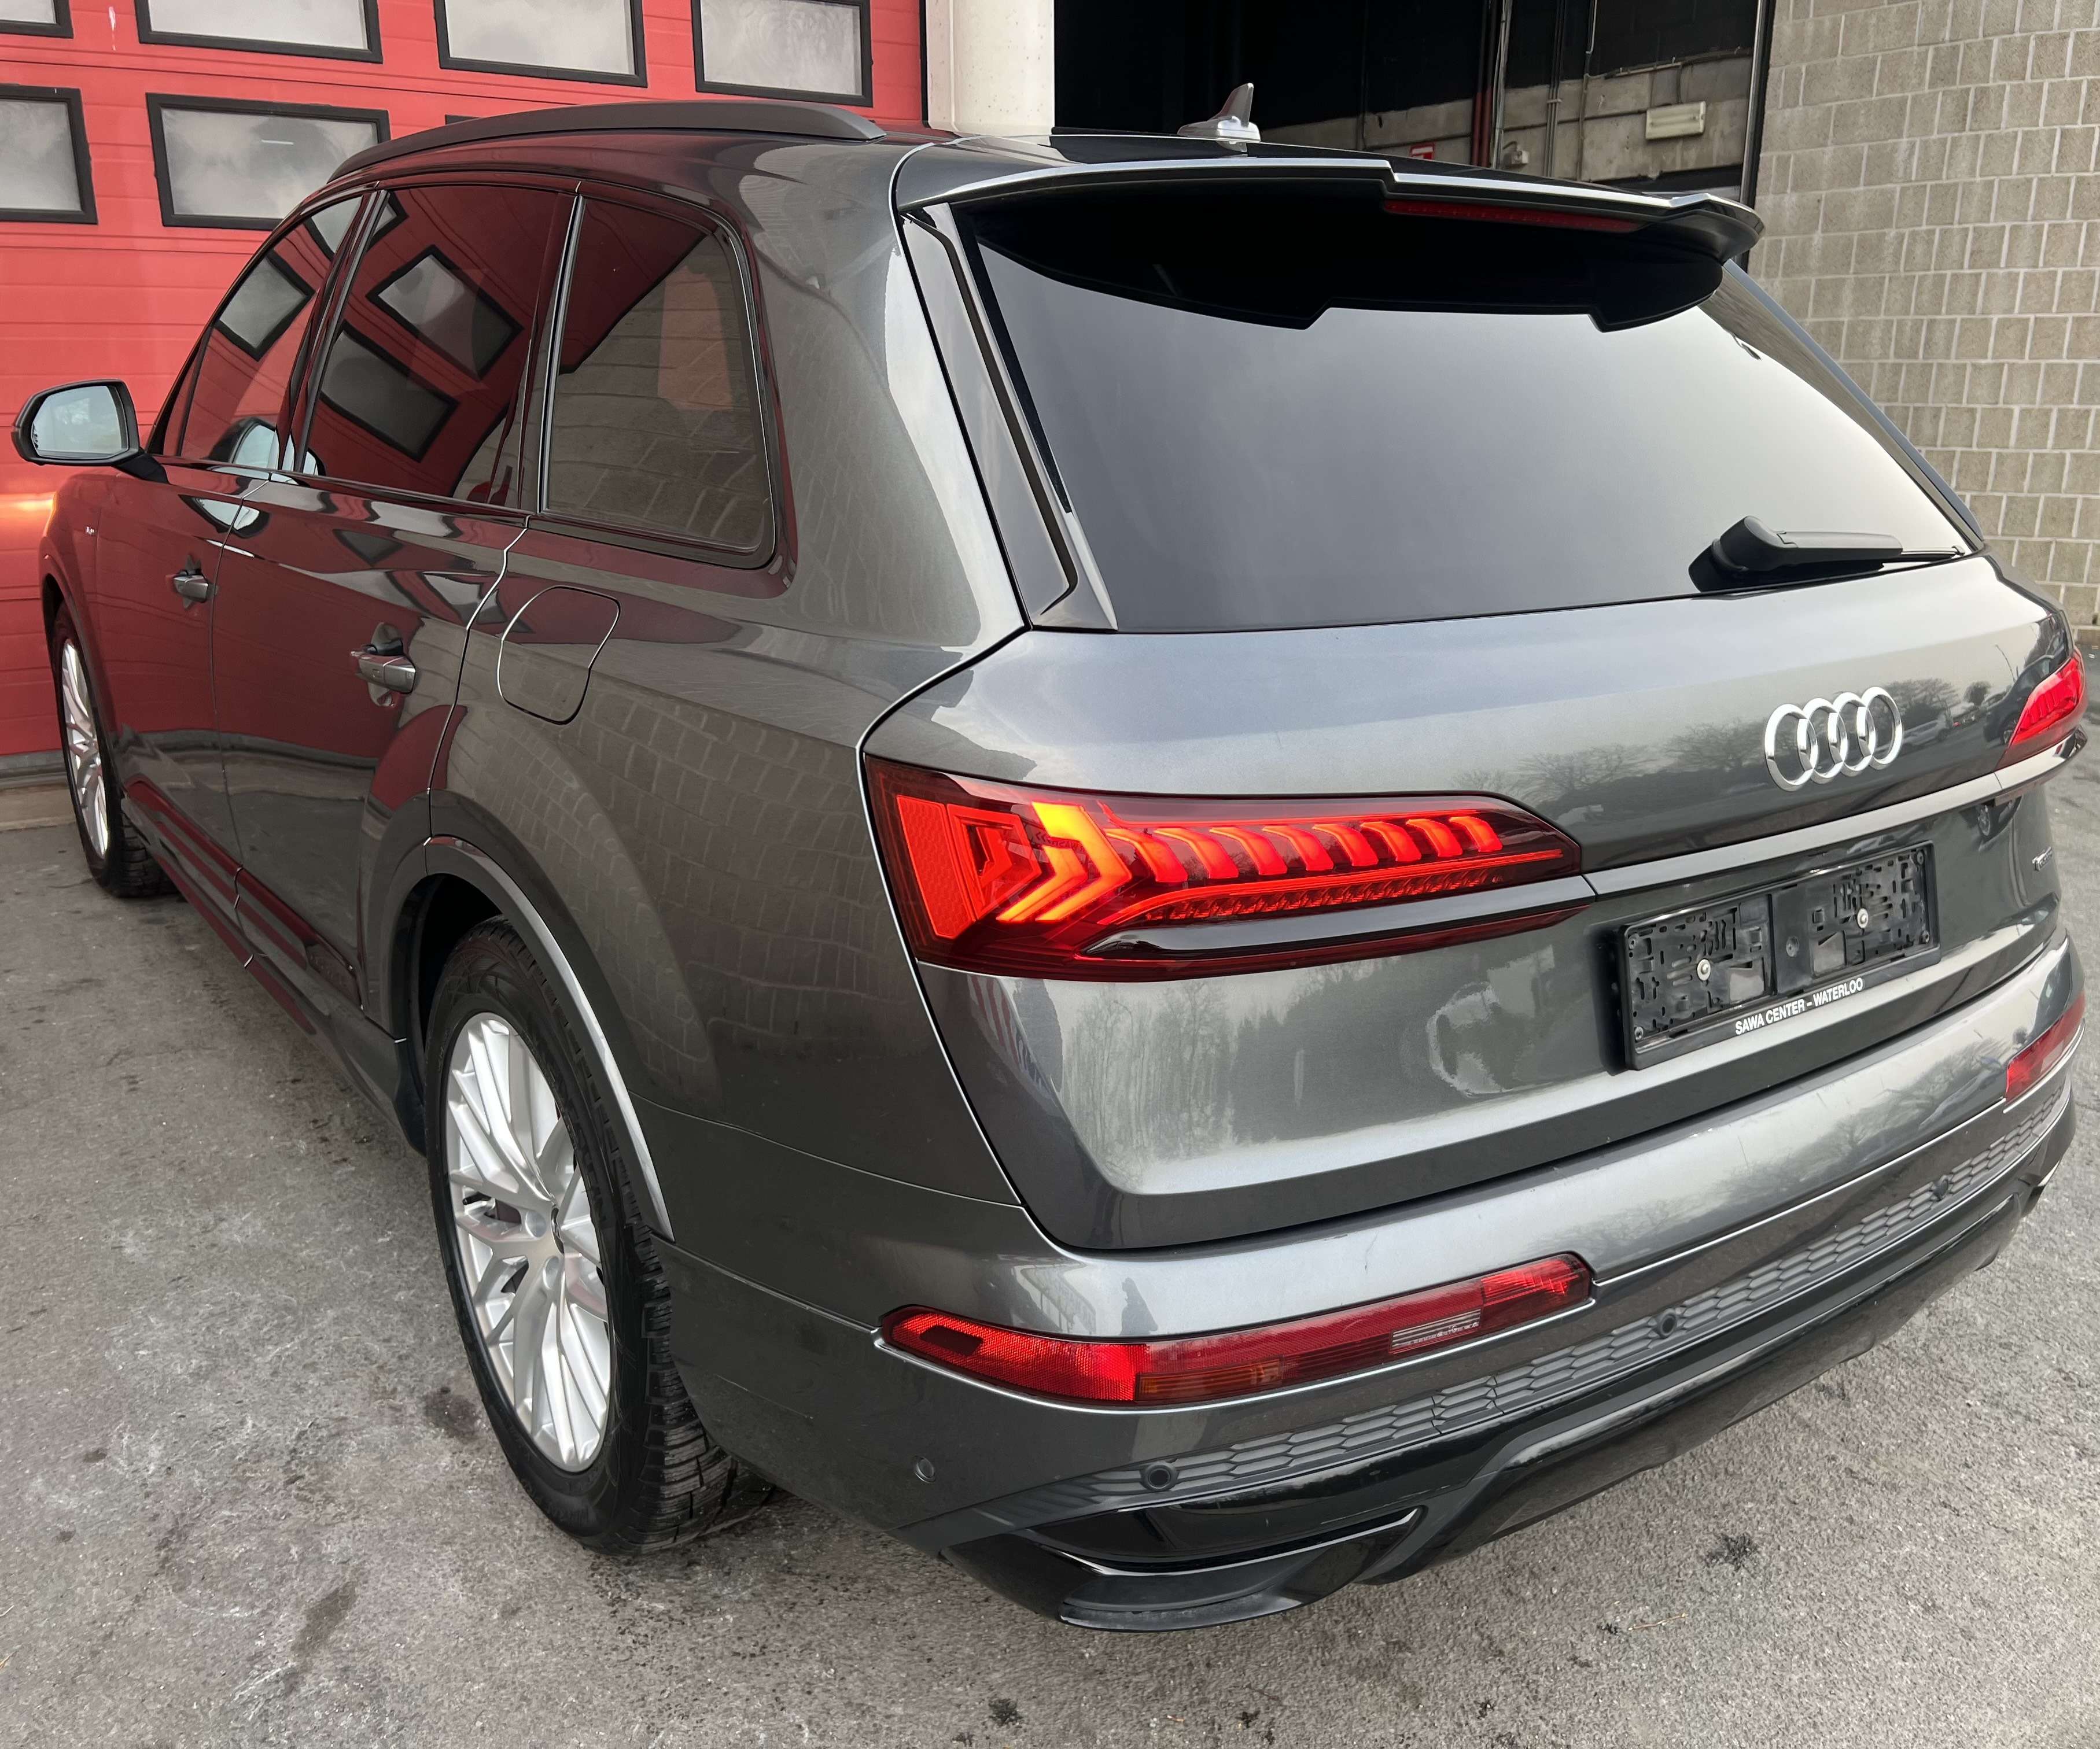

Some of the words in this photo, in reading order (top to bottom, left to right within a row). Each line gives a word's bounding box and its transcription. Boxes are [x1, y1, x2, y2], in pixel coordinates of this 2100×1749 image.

[1736, 1013, 1764, 1035] SAWA
[1766, 999, 1805, 1024] CENTER
[1812, 977, 1863, 1006] WATERLOO
